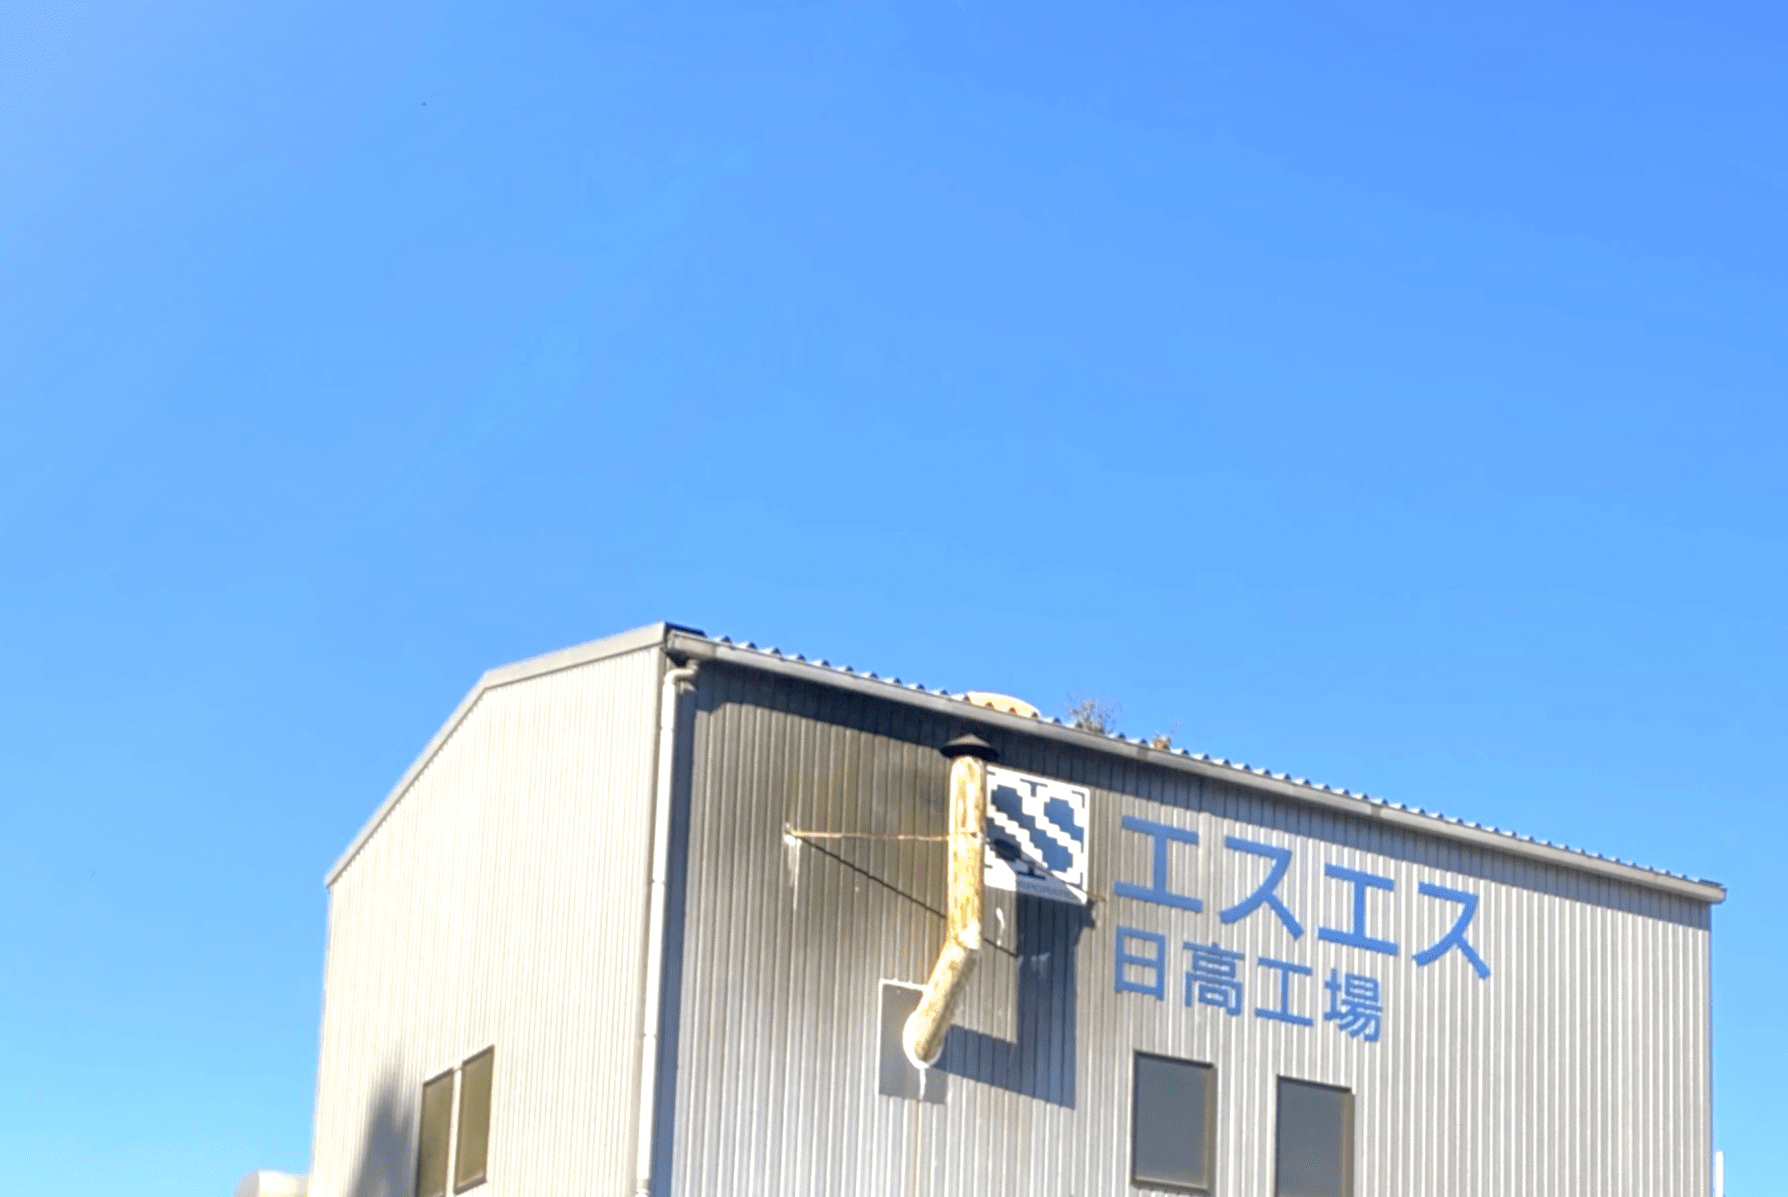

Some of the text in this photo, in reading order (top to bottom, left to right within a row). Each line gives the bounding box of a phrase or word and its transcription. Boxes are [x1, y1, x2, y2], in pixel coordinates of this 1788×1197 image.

[1113, 815, 1492, 981] エスエス
[1113, 924, 1384, 1044] 日高工場
